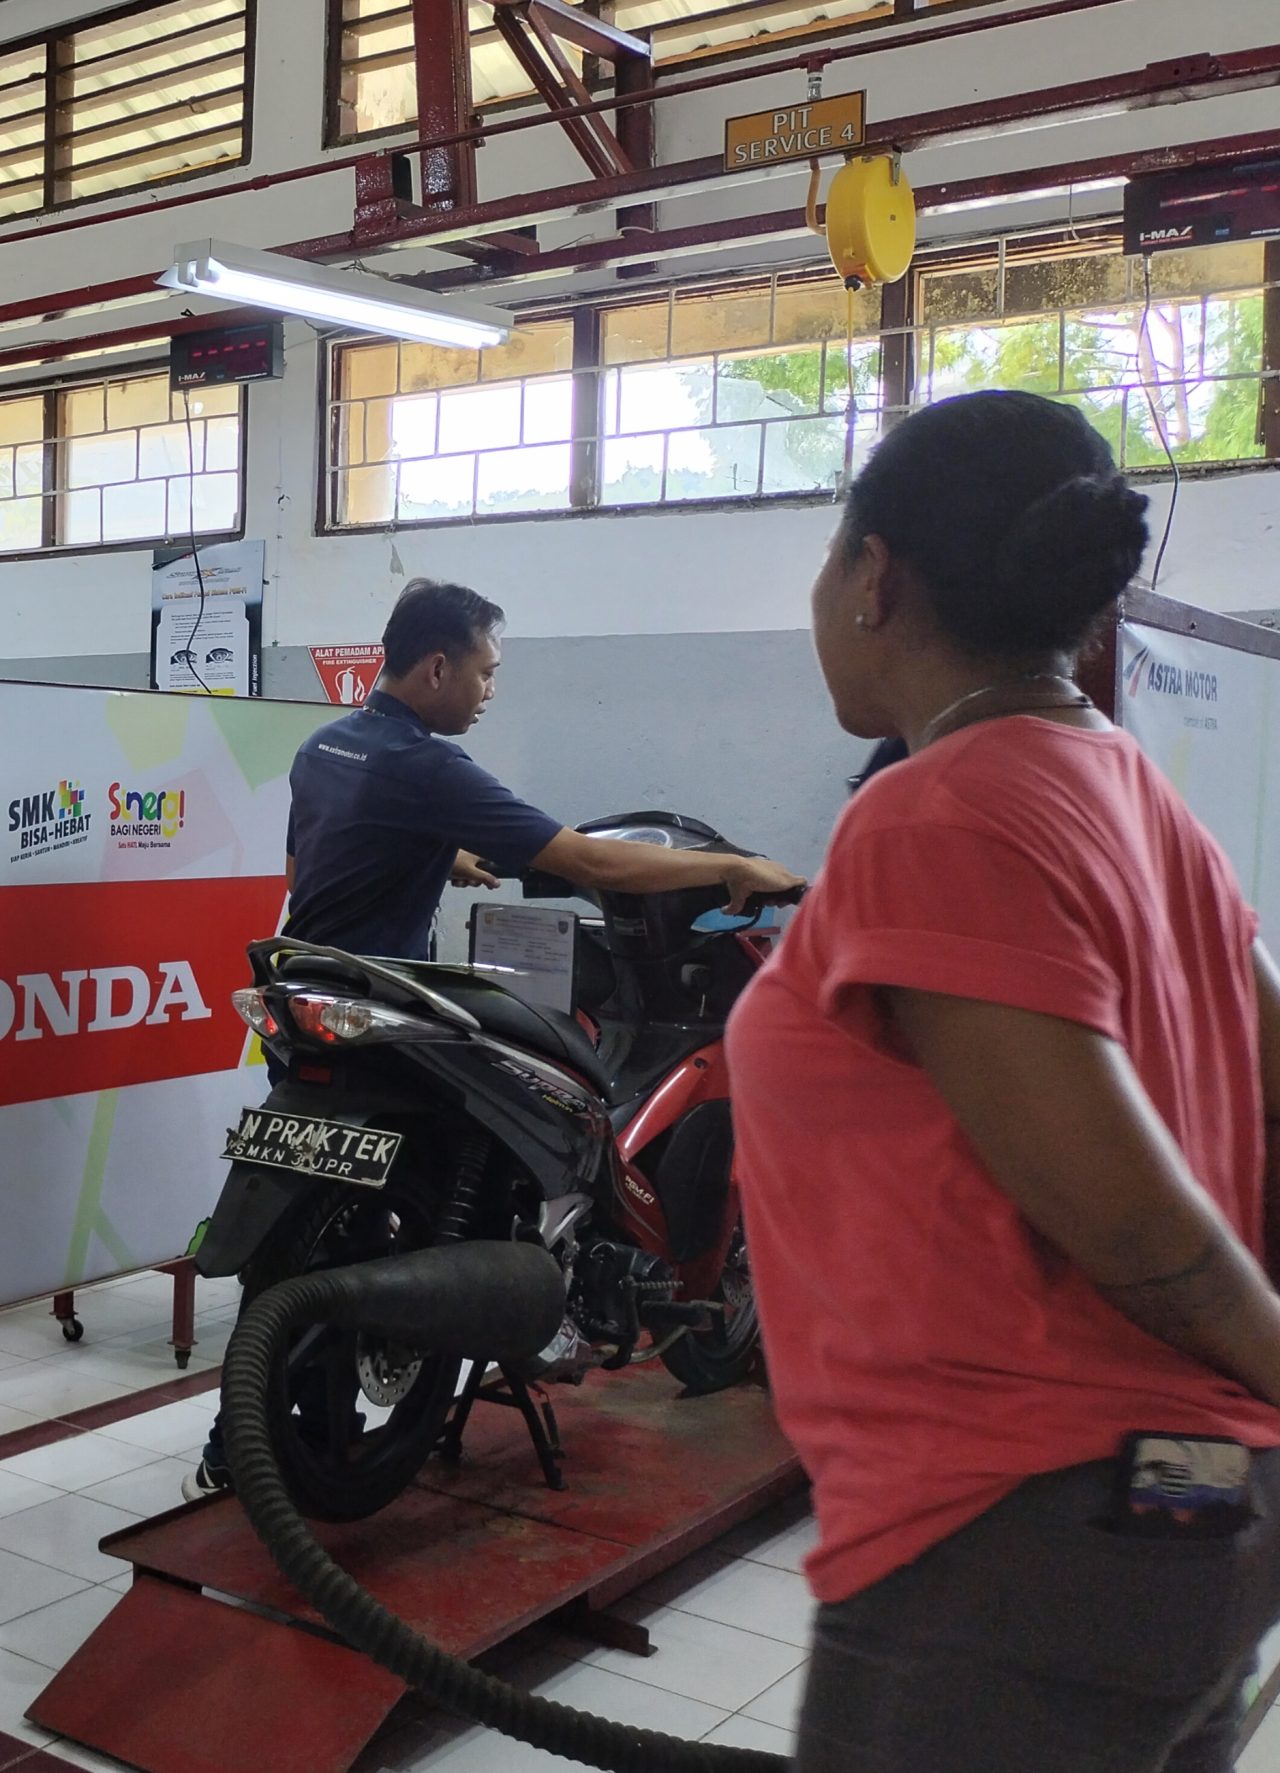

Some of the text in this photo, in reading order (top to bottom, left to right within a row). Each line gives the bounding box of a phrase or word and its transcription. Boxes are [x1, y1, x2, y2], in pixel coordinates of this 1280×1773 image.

[773, 107, 813, 134] PIT
[735, 123, 855, 163] SERVICE 4
[315, 648, 333, 657] ALAT
[335, 647, 371, 657] PEMADAM
[1147, 662, 1218, 702] ASTRA MOTOR
[8, 790, 56, 832] SMK
[20, 813, 91, 850] BISA-HEBAT
[110, 824, 161, 836] BAGI NEGERI
[234, 1142, 286, 1163] SMKN
[264, 1117, 396, 1164] PRAKTEK
